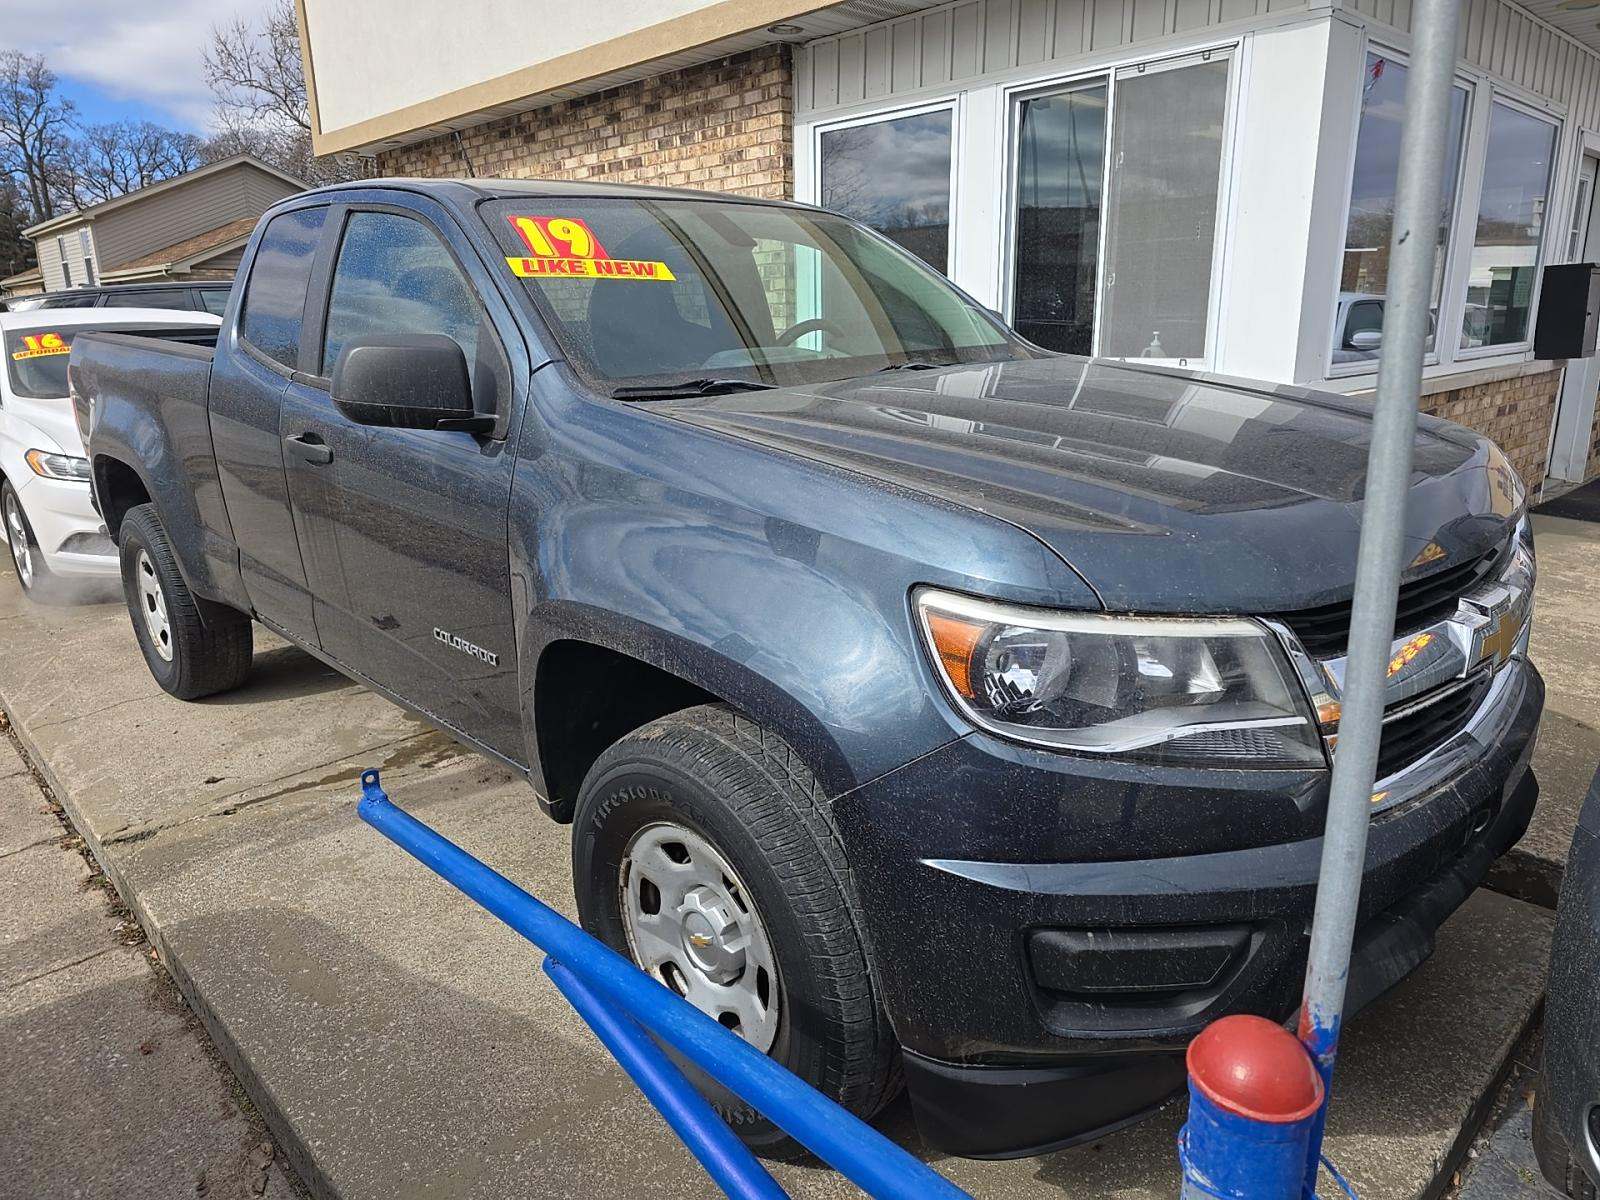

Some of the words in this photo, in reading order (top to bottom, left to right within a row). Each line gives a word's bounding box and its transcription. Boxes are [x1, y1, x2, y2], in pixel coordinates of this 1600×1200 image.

[516, 217, 595, 257] 19
[522, 259, 587, 275] LIKE
[594, 261, 658, 277] NEW
[24, 333, 63, 350] 16
[433, 627, 498, 667] COLORADO
